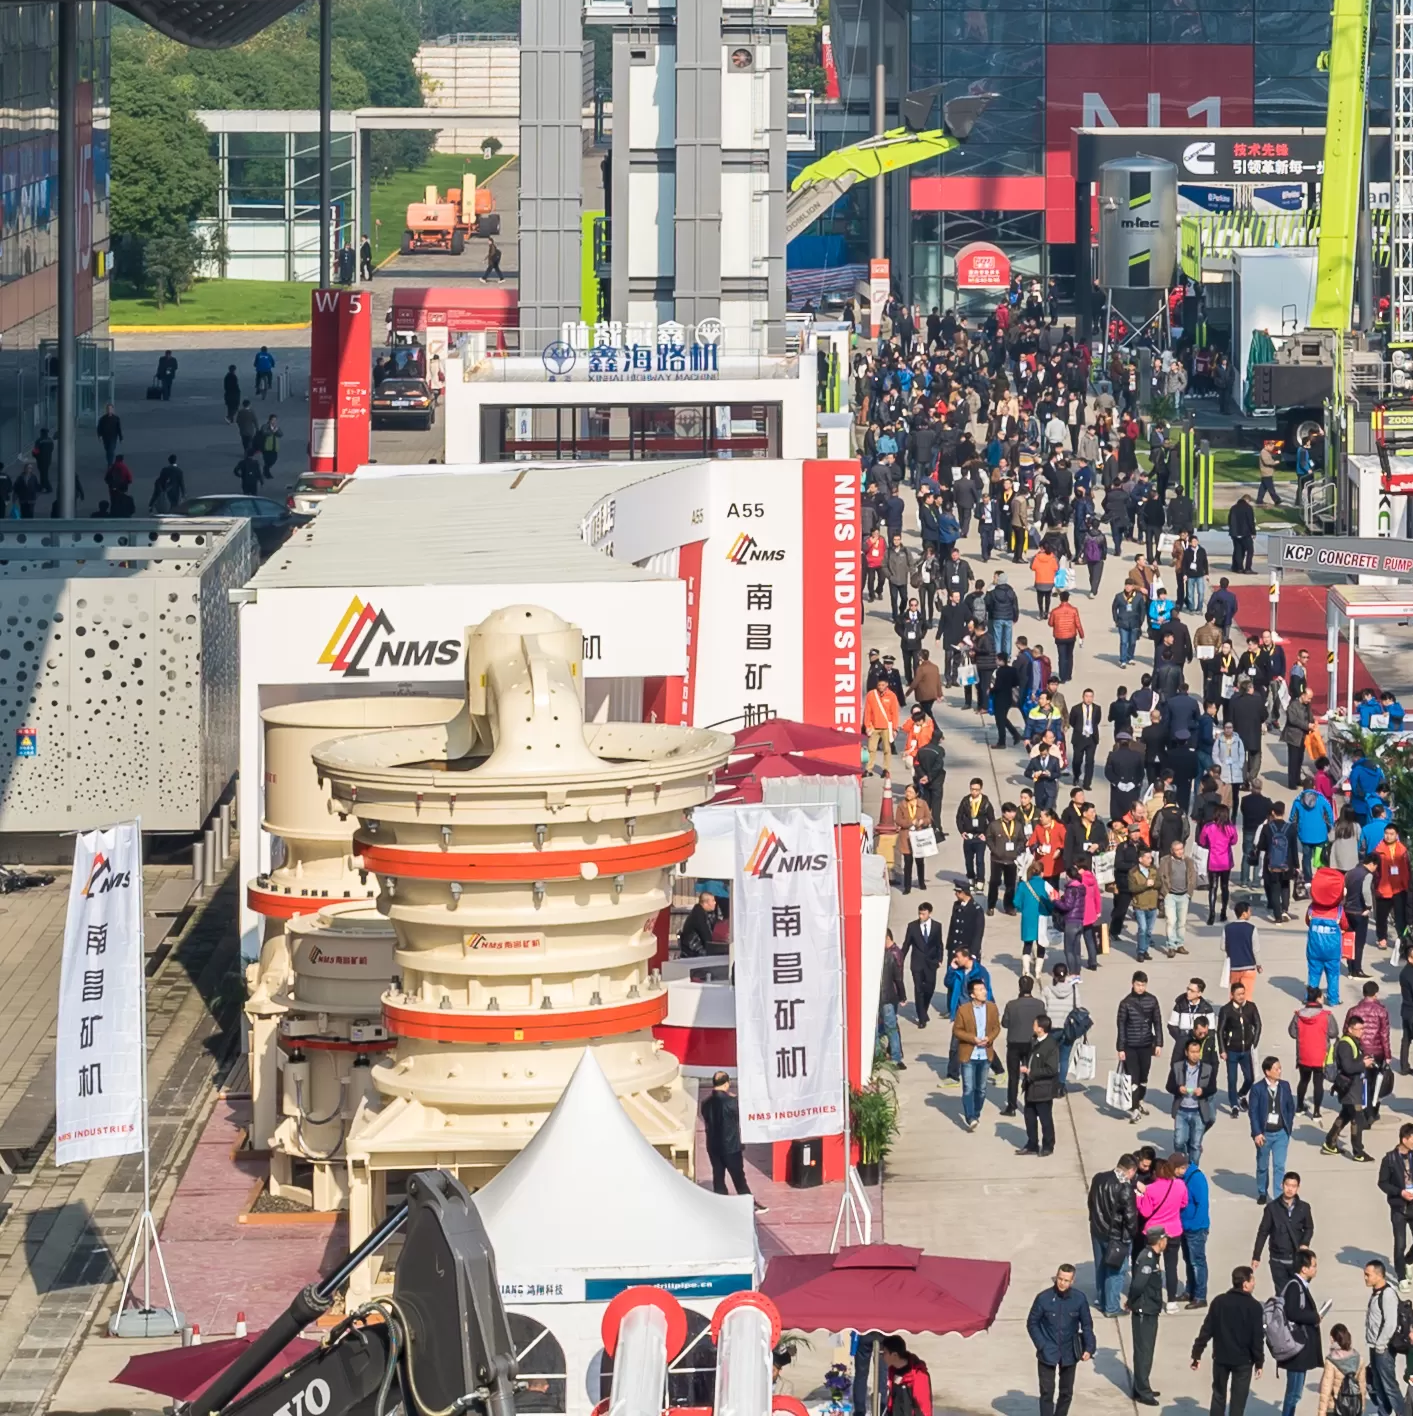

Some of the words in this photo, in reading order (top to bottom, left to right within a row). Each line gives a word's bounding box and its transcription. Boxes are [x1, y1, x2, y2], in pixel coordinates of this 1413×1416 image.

[1233, 143, 1289, 157] 技术先锋
[315, 292, 339, 313] W
[349, 294, 362, 314] 5
[588, 343, 719, 372] 鑫海路机
[727, 502, 765, 519] A55
[834, 474, 856, 541] NMS
[749, 549, 786, 562] NMS
[1285, 545, 1314, 562] KCP
[1318, 549, 1379, 569] CONCRETE
[1383, 555, 1413, 572] PUMP
[375, 639, 461, 666] NMS
[777, 853, 828, 873] NMS
[771, 904, 807, 1079] 南昌矿机
[78, 923, 108, 1098] 南昌矿机
[774, 1105, 837, 1119] INDUSTRIES
[74, 1124, 135, 1139] INDUSTRIES
